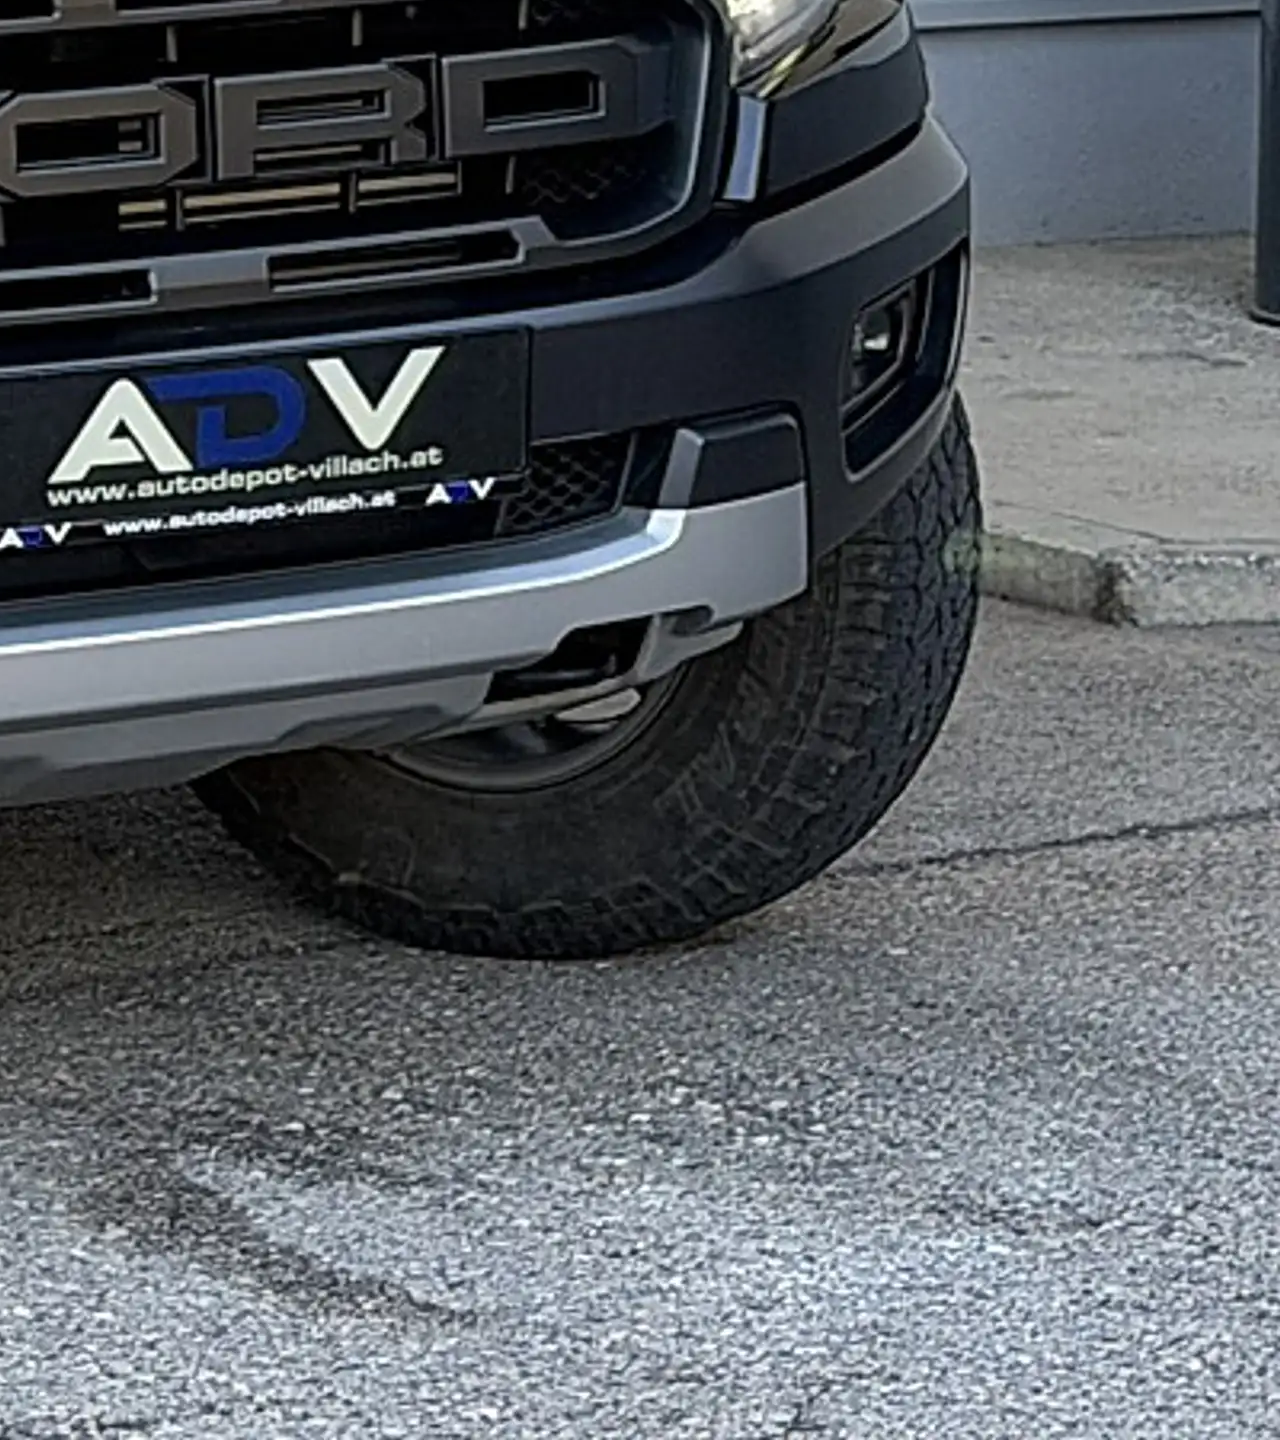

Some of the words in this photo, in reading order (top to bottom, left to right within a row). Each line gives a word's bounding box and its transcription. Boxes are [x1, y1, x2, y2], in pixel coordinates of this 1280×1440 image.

[47, 345, 446, 486] ADV
[46, 447, 445, 507] www.autodepot-villach.at
[102, 489, 398, 537] www.autodepot-villach.at
